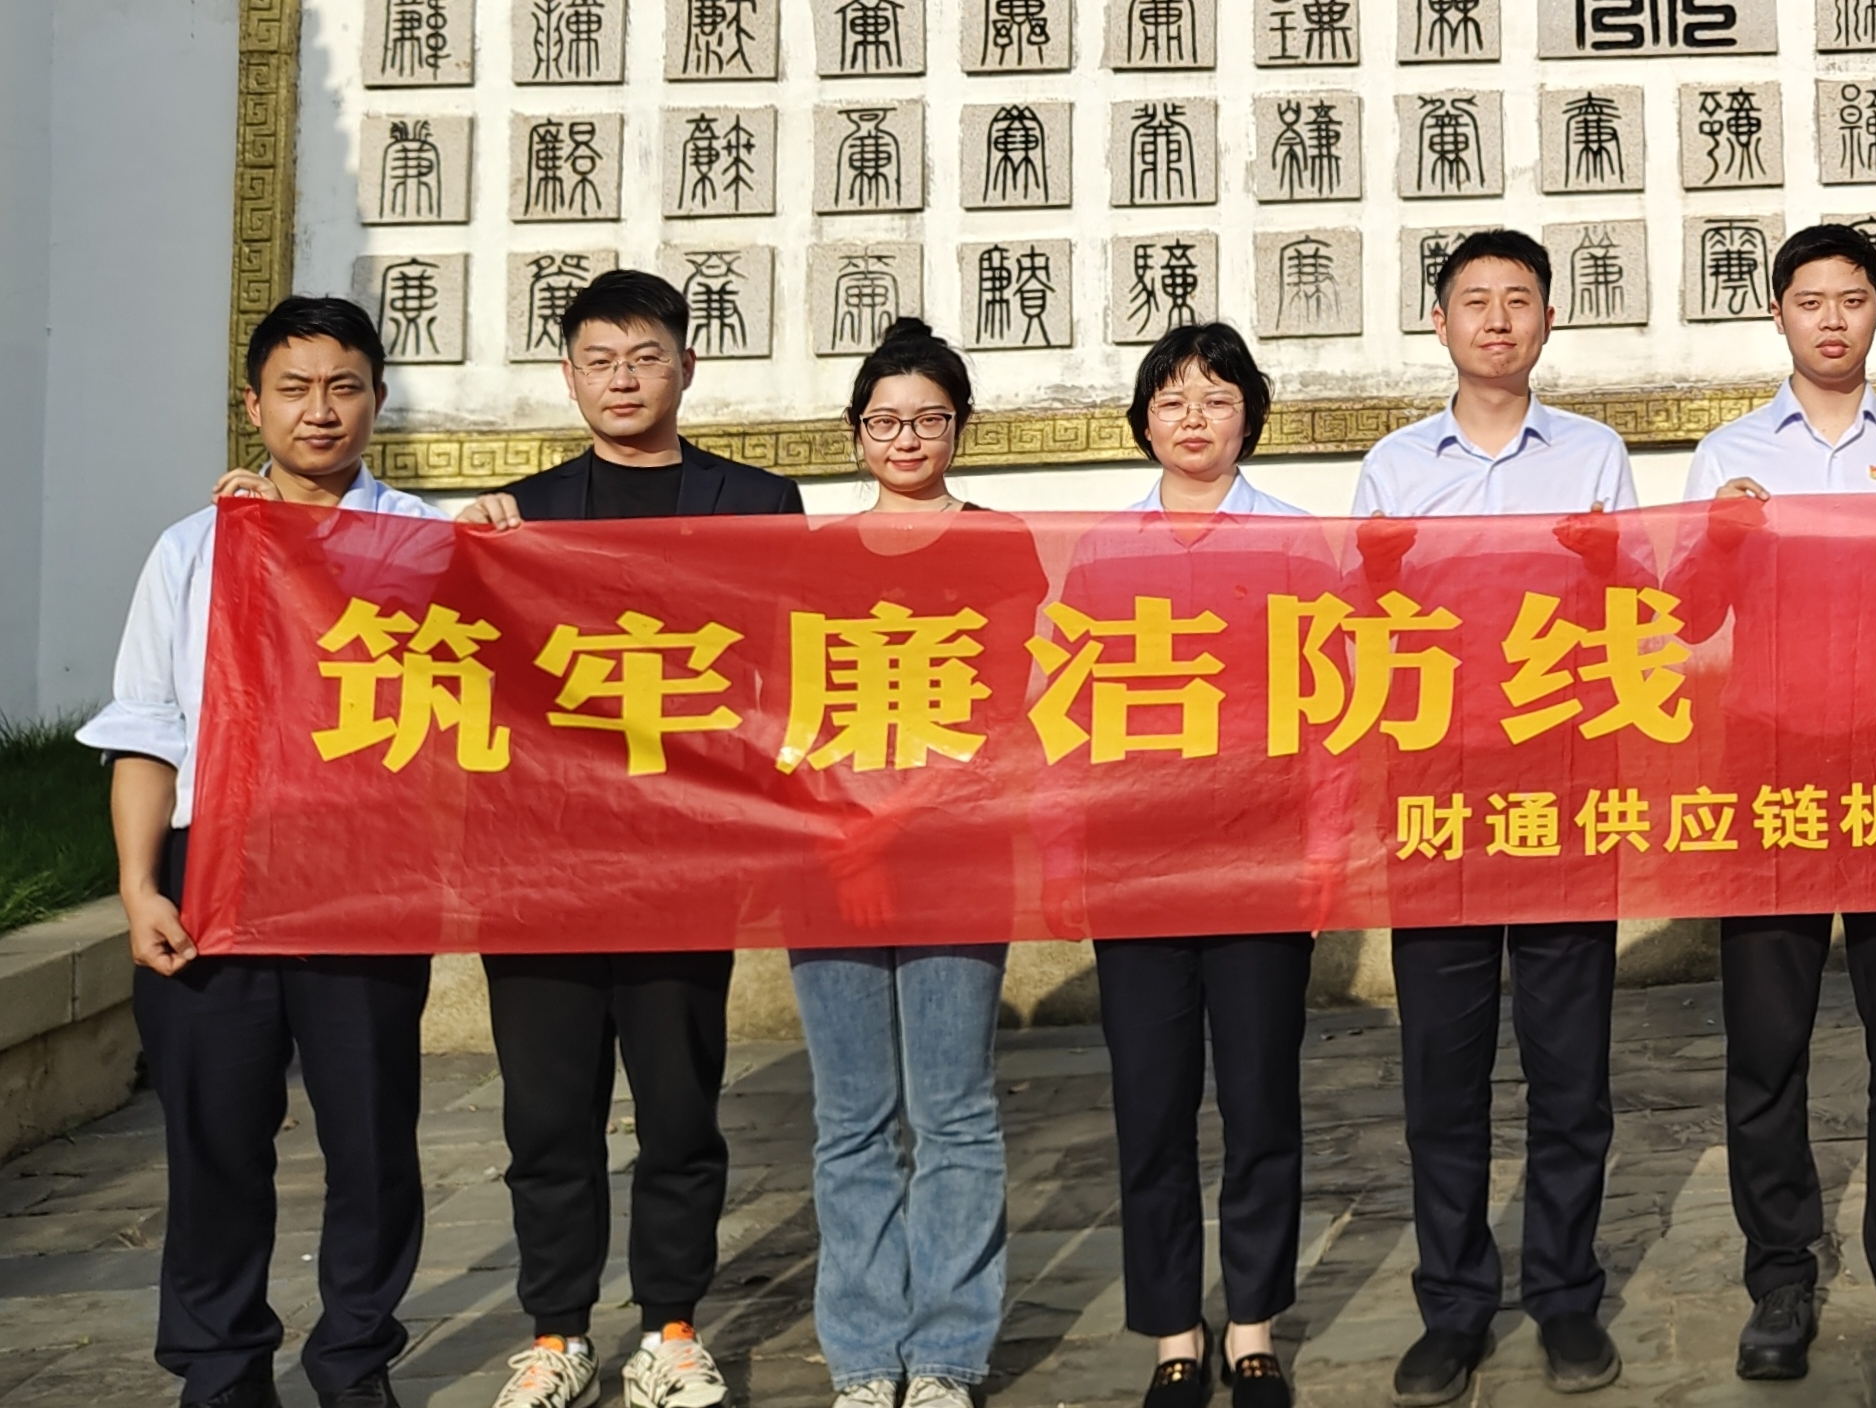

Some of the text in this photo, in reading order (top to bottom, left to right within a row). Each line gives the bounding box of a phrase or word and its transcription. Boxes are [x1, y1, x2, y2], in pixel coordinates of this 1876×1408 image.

[312, 587, 1693, 777] 筑牢廉洁防线
